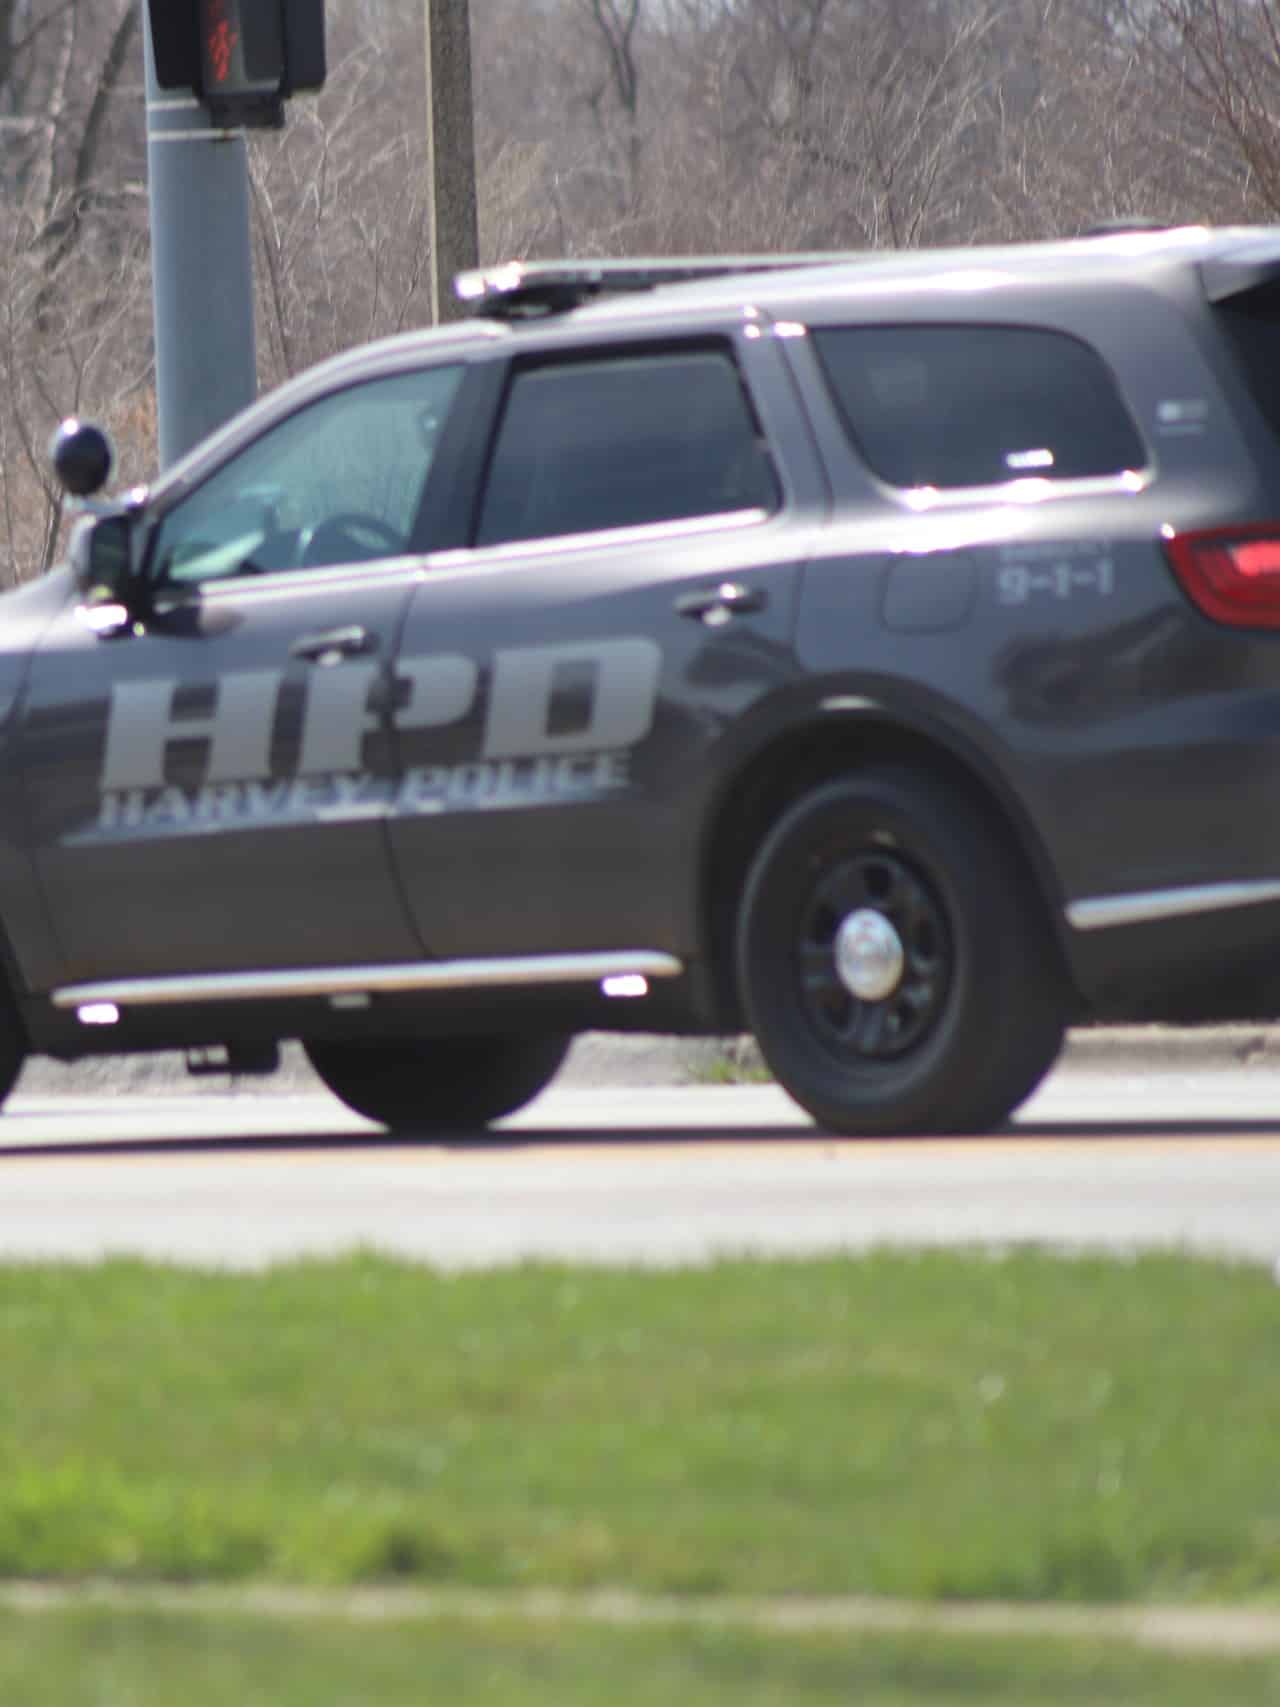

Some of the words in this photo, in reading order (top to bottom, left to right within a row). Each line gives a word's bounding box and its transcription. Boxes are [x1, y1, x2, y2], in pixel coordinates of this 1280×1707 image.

[998, 557, 1114, 604] 9-1-1
[99, 637, 662, 791] HPD
[98, 773, 373, 829] HARVEY
[400, 752, 632, 795] POLICE
